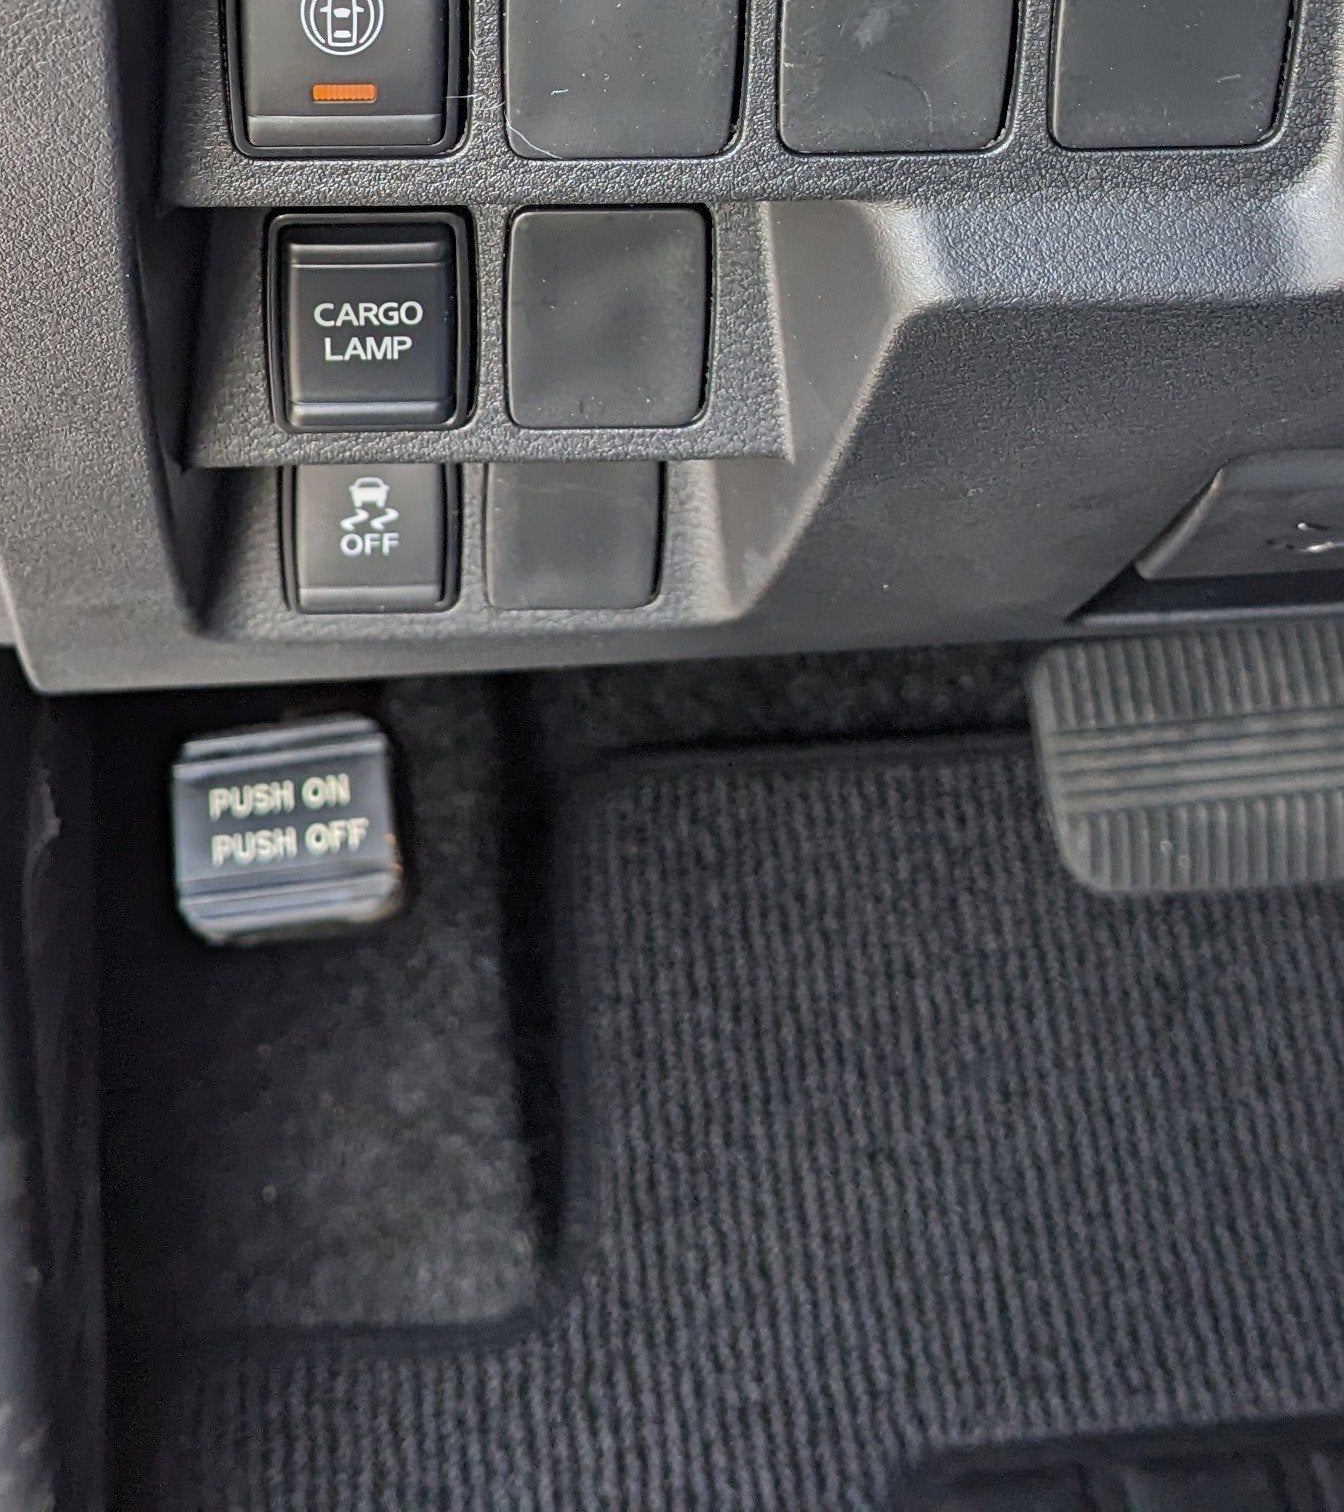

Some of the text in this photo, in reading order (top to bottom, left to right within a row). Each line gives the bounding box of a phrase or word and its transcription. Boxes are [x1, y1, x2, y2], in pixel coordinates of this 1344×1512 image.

[313, 300, 424, 328] CARGO
[323, 336, 413, 362] LAMP
[339, 532, 400, 557] OFF
[208, 772, 351, 822] PUSH ON
[211, 816, 370, 868] PUSH OFF
